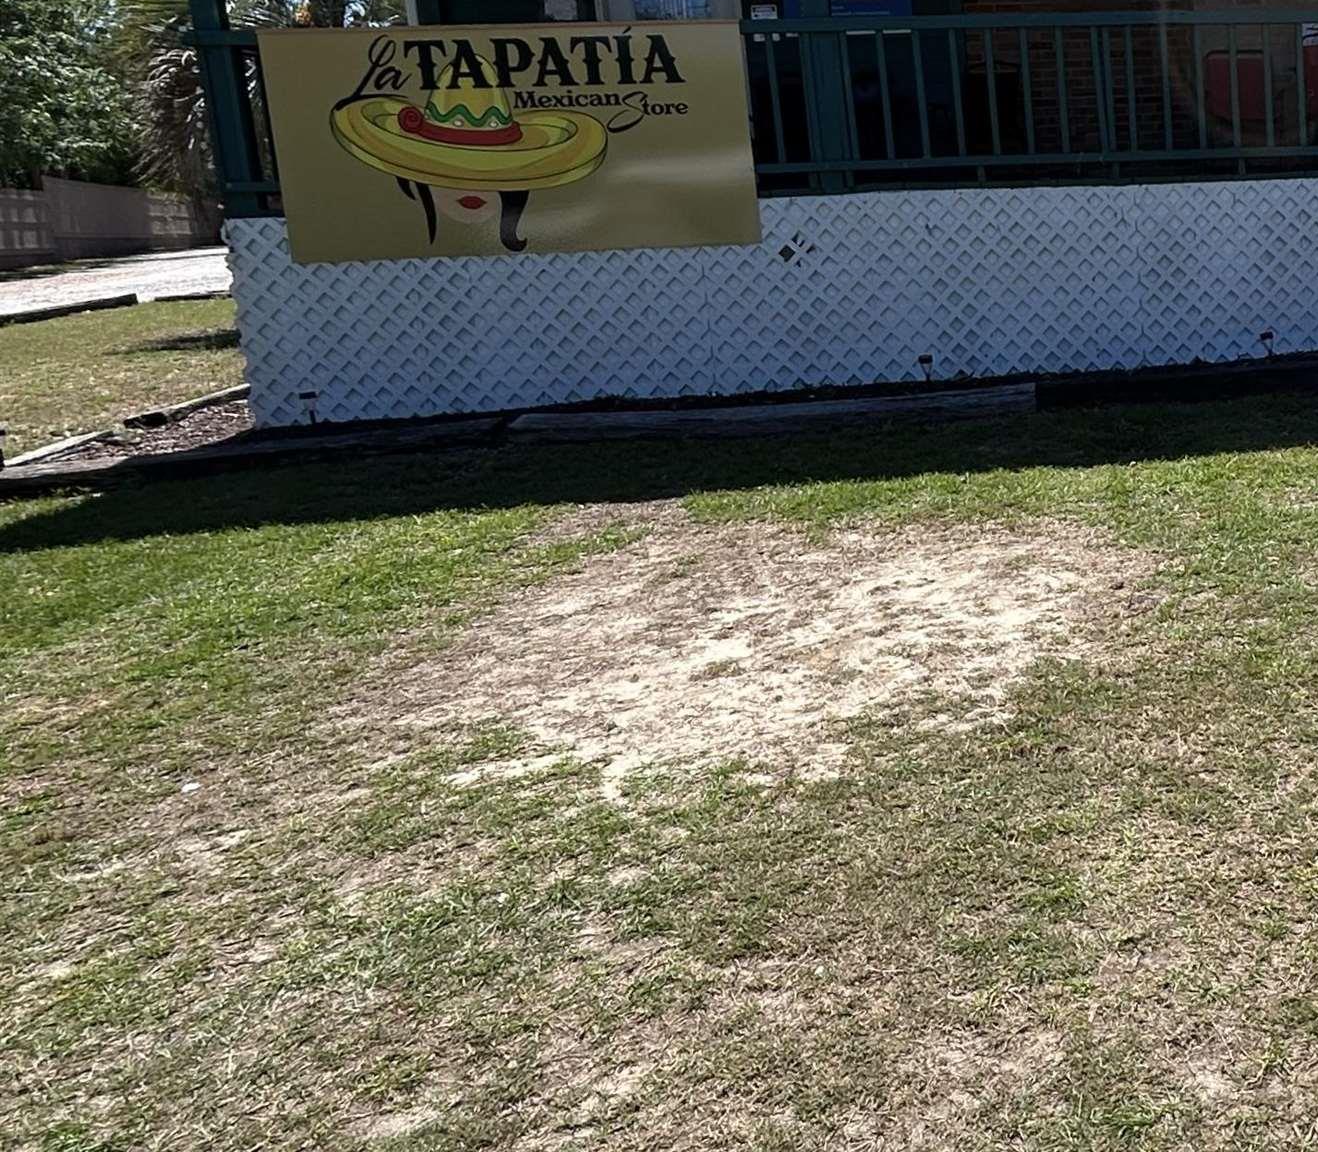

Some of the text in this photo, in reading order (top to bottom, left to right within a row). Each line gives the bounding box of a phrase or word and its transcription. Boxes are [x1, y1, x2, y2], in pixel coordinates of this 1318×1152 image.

[335, 26, 686, 111] La TAPATÍA
[513, 90, 689, 133] Mexican Store
